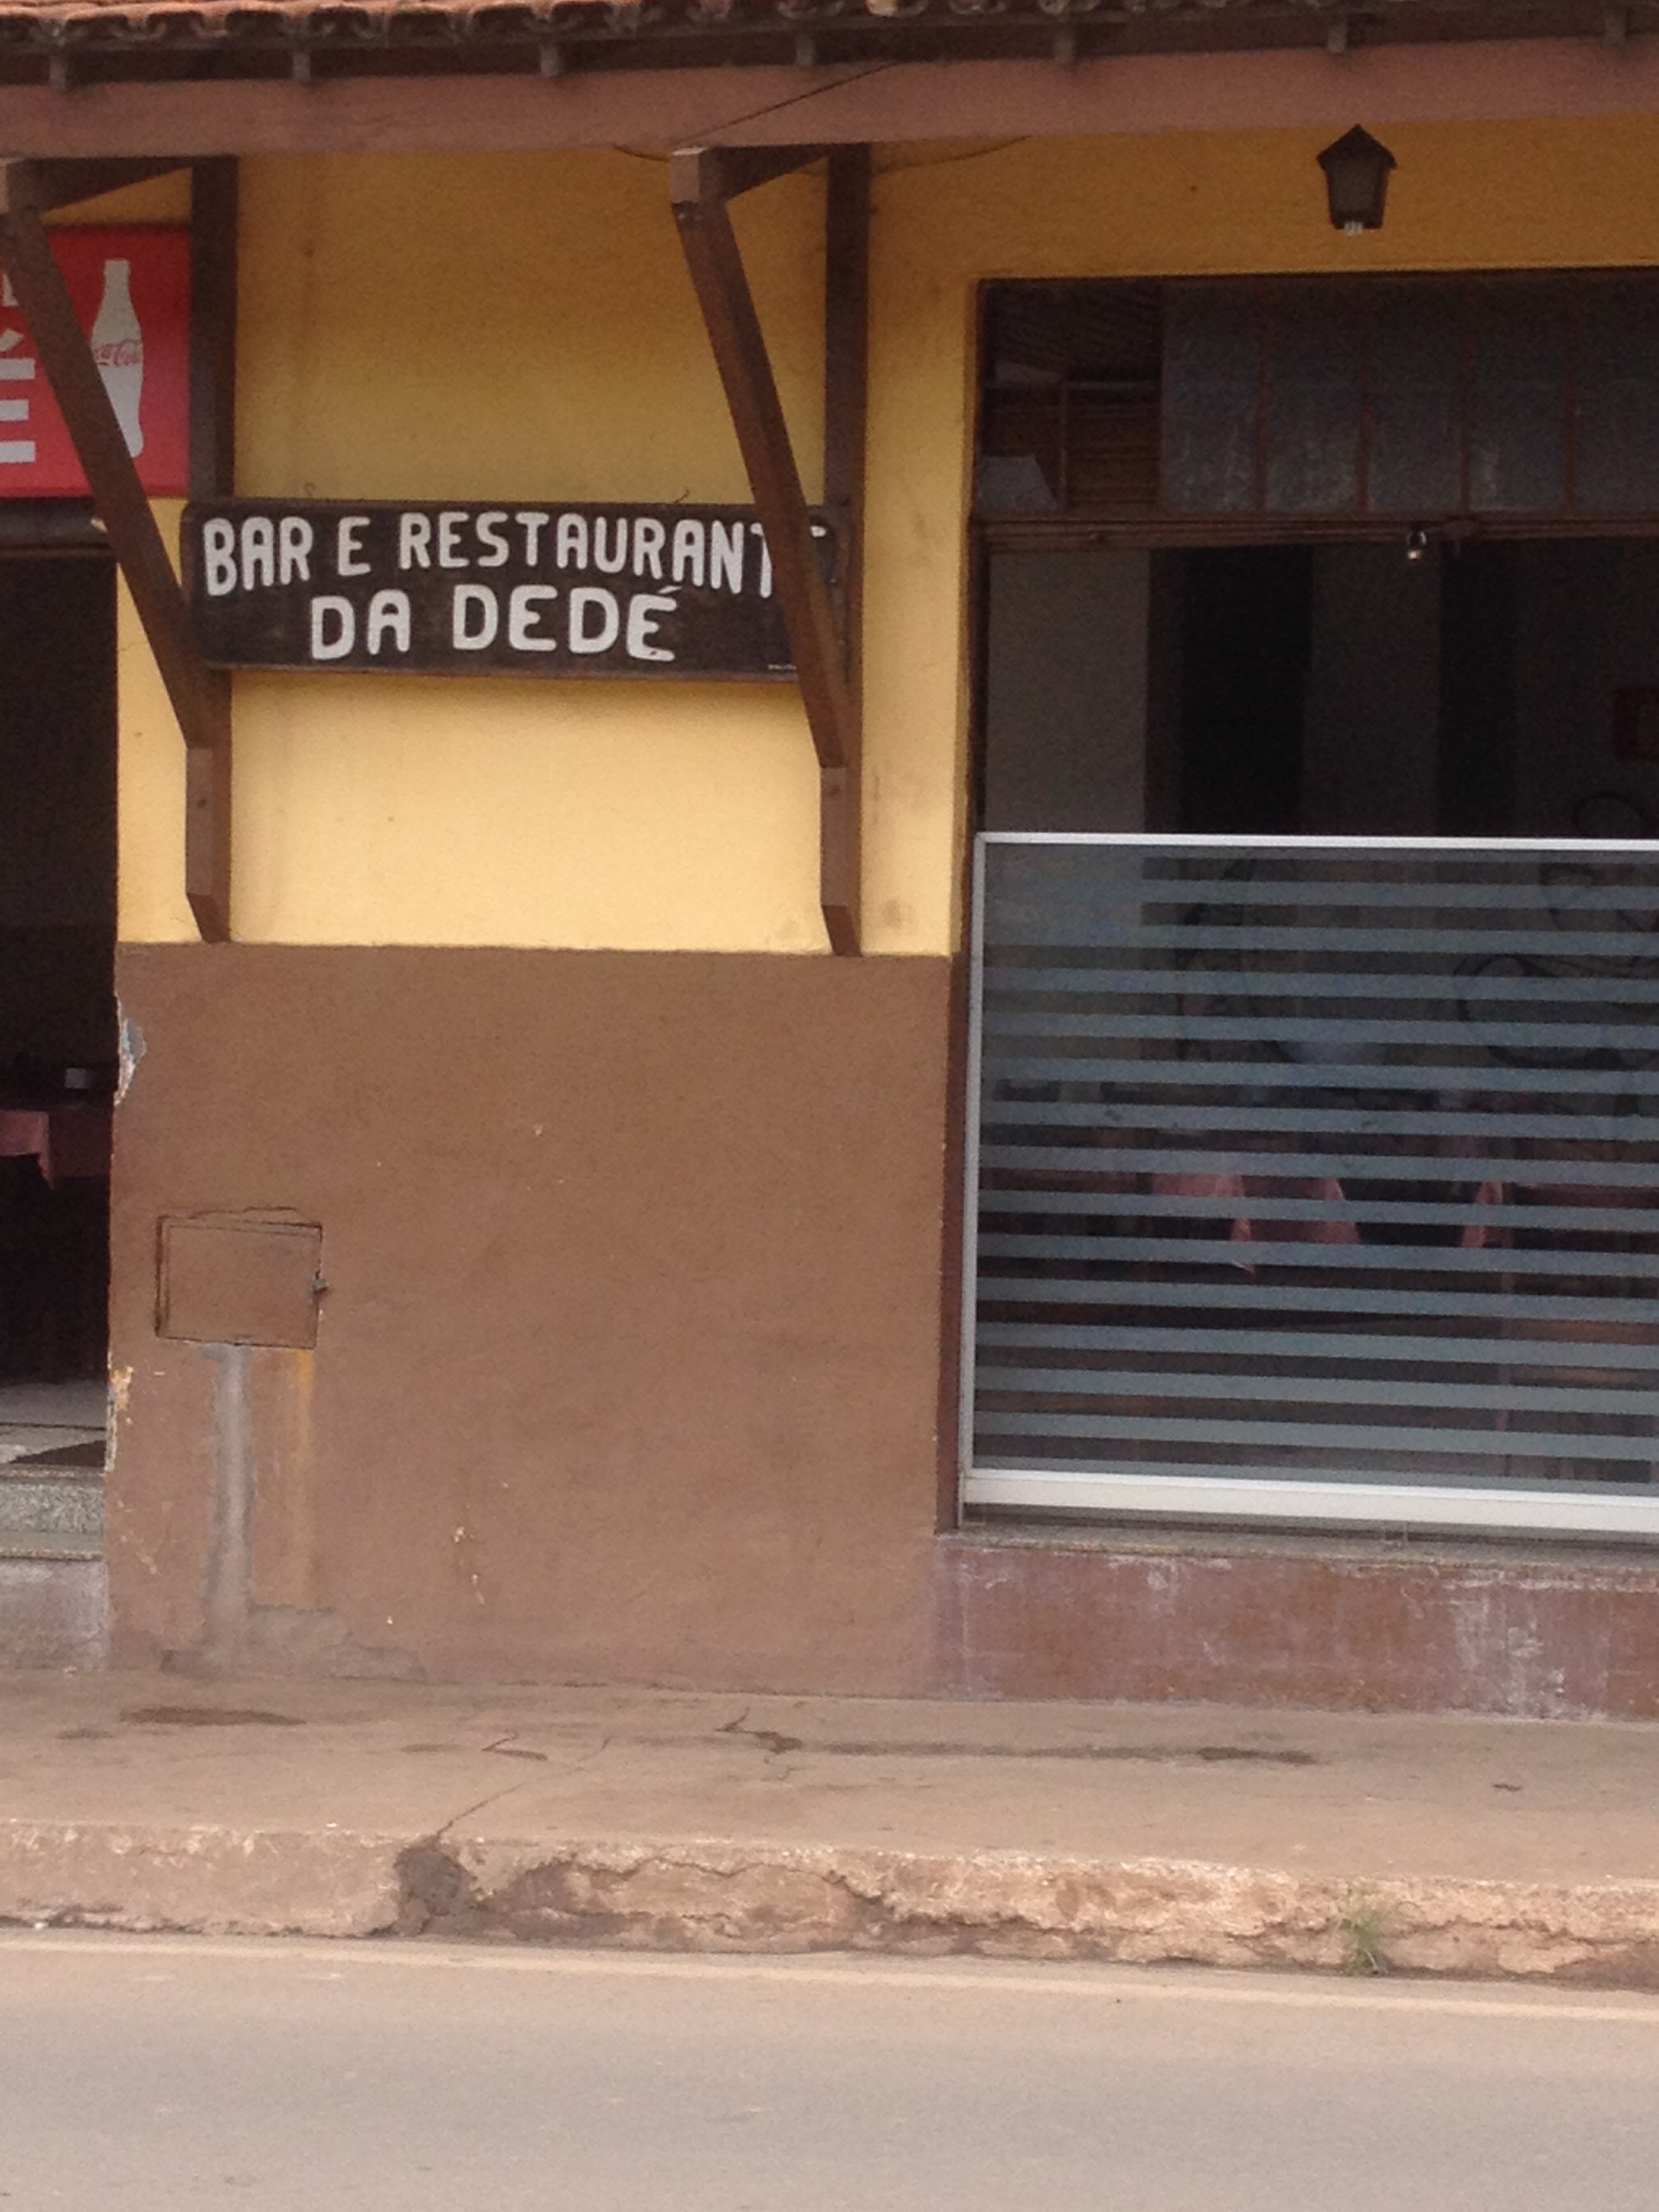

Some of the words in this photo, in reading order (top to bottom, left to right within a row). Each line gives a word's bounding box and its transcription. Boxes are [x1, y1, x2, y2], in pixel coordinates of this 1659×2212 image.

[203, 517, 314, 596] BAR
[338, 517, 372, 576] E
[398, 512, 826, 599] RESTAURANT
[311, 588, 410, 660] DA
[452, 583, 678, 662] DEDÉ
